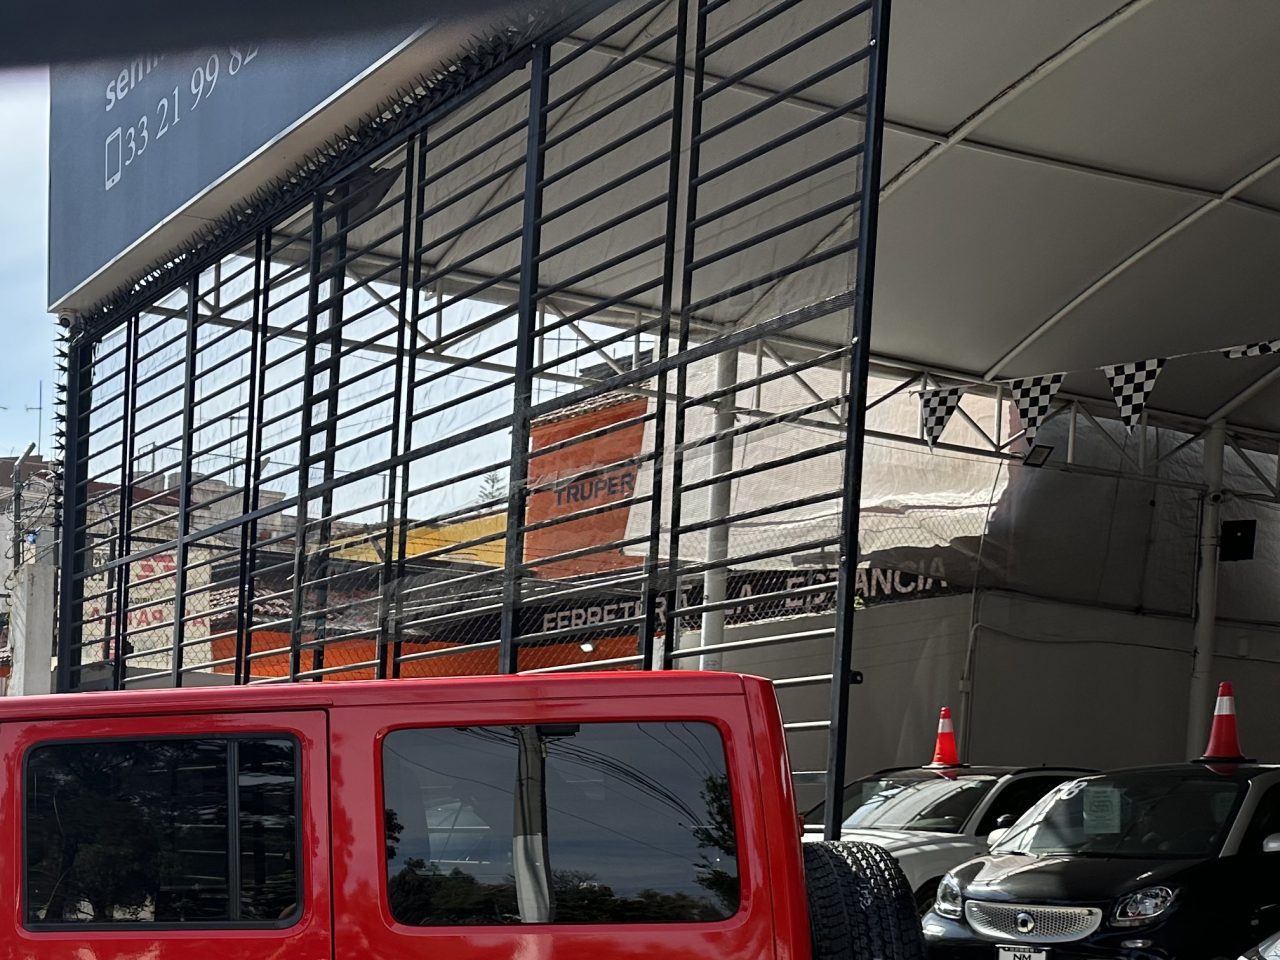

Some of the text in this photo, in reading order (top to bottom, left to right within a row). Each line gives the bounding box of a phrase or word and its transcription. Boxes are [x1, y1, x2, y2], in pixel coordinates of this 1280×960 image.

[124, 115, 148, 166] 33
[156, 86, 180, 140] 21
[190, 53, 220, 111] 99
[553, 472, 635, 506] TRUPER
